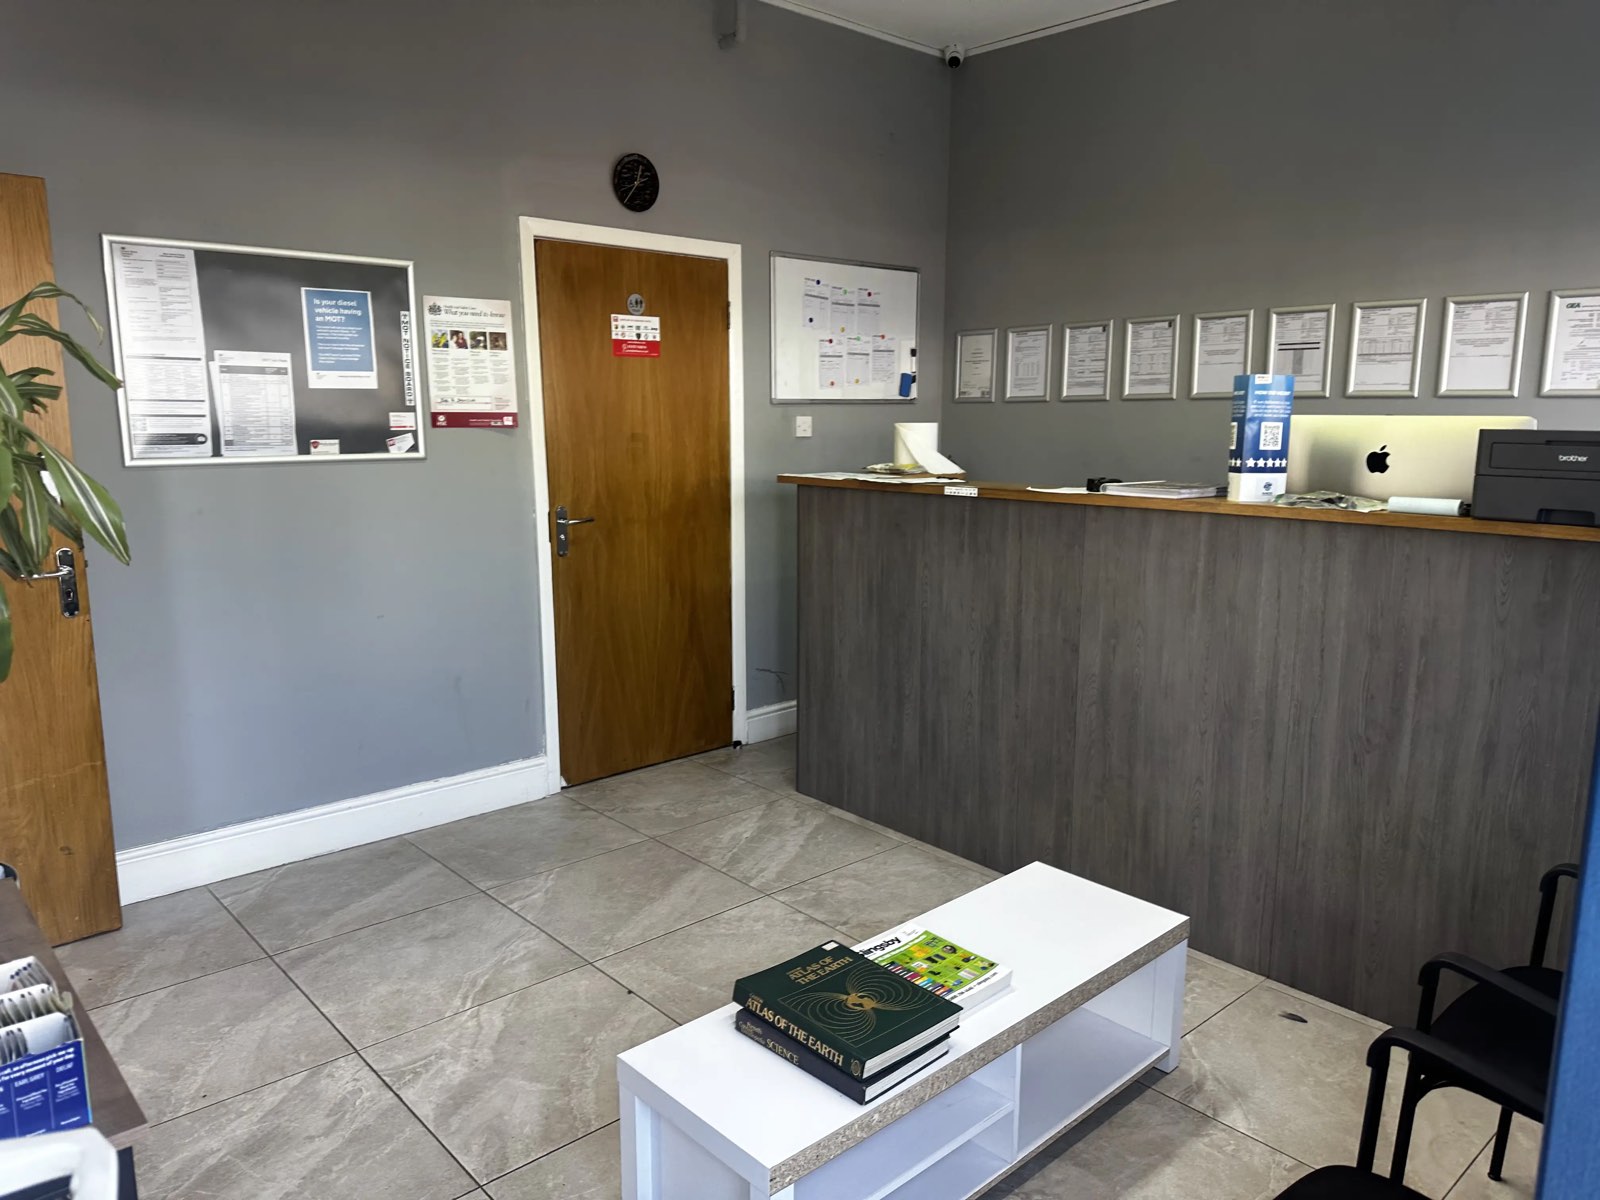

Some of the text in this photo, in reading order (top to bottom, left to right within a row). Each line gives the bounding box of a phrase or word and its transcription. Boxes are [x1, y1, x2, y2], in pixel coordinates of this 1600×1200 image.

[336, 299, 357, 307] diesel
[339, 308, 362, 316] having
[401, 320, 410, 335] MOT
[404, 371, 414, 398] BOARD
[1558, 454, 1588, 462] brother
[859, 936, 902, 956] lingsby
[787, 956, 833, 981] ATLAS OF
[795, 956, 853, 985] THE EARTH
[745, 998, 775, 1022] ATLAS
[774, 1015, 789, 1030] OF
[788, 1022, 808, 1044] THE
[807, 1035, 844, 1066] EARTH
[766, 1038, 800, 1065] SCIENCE
